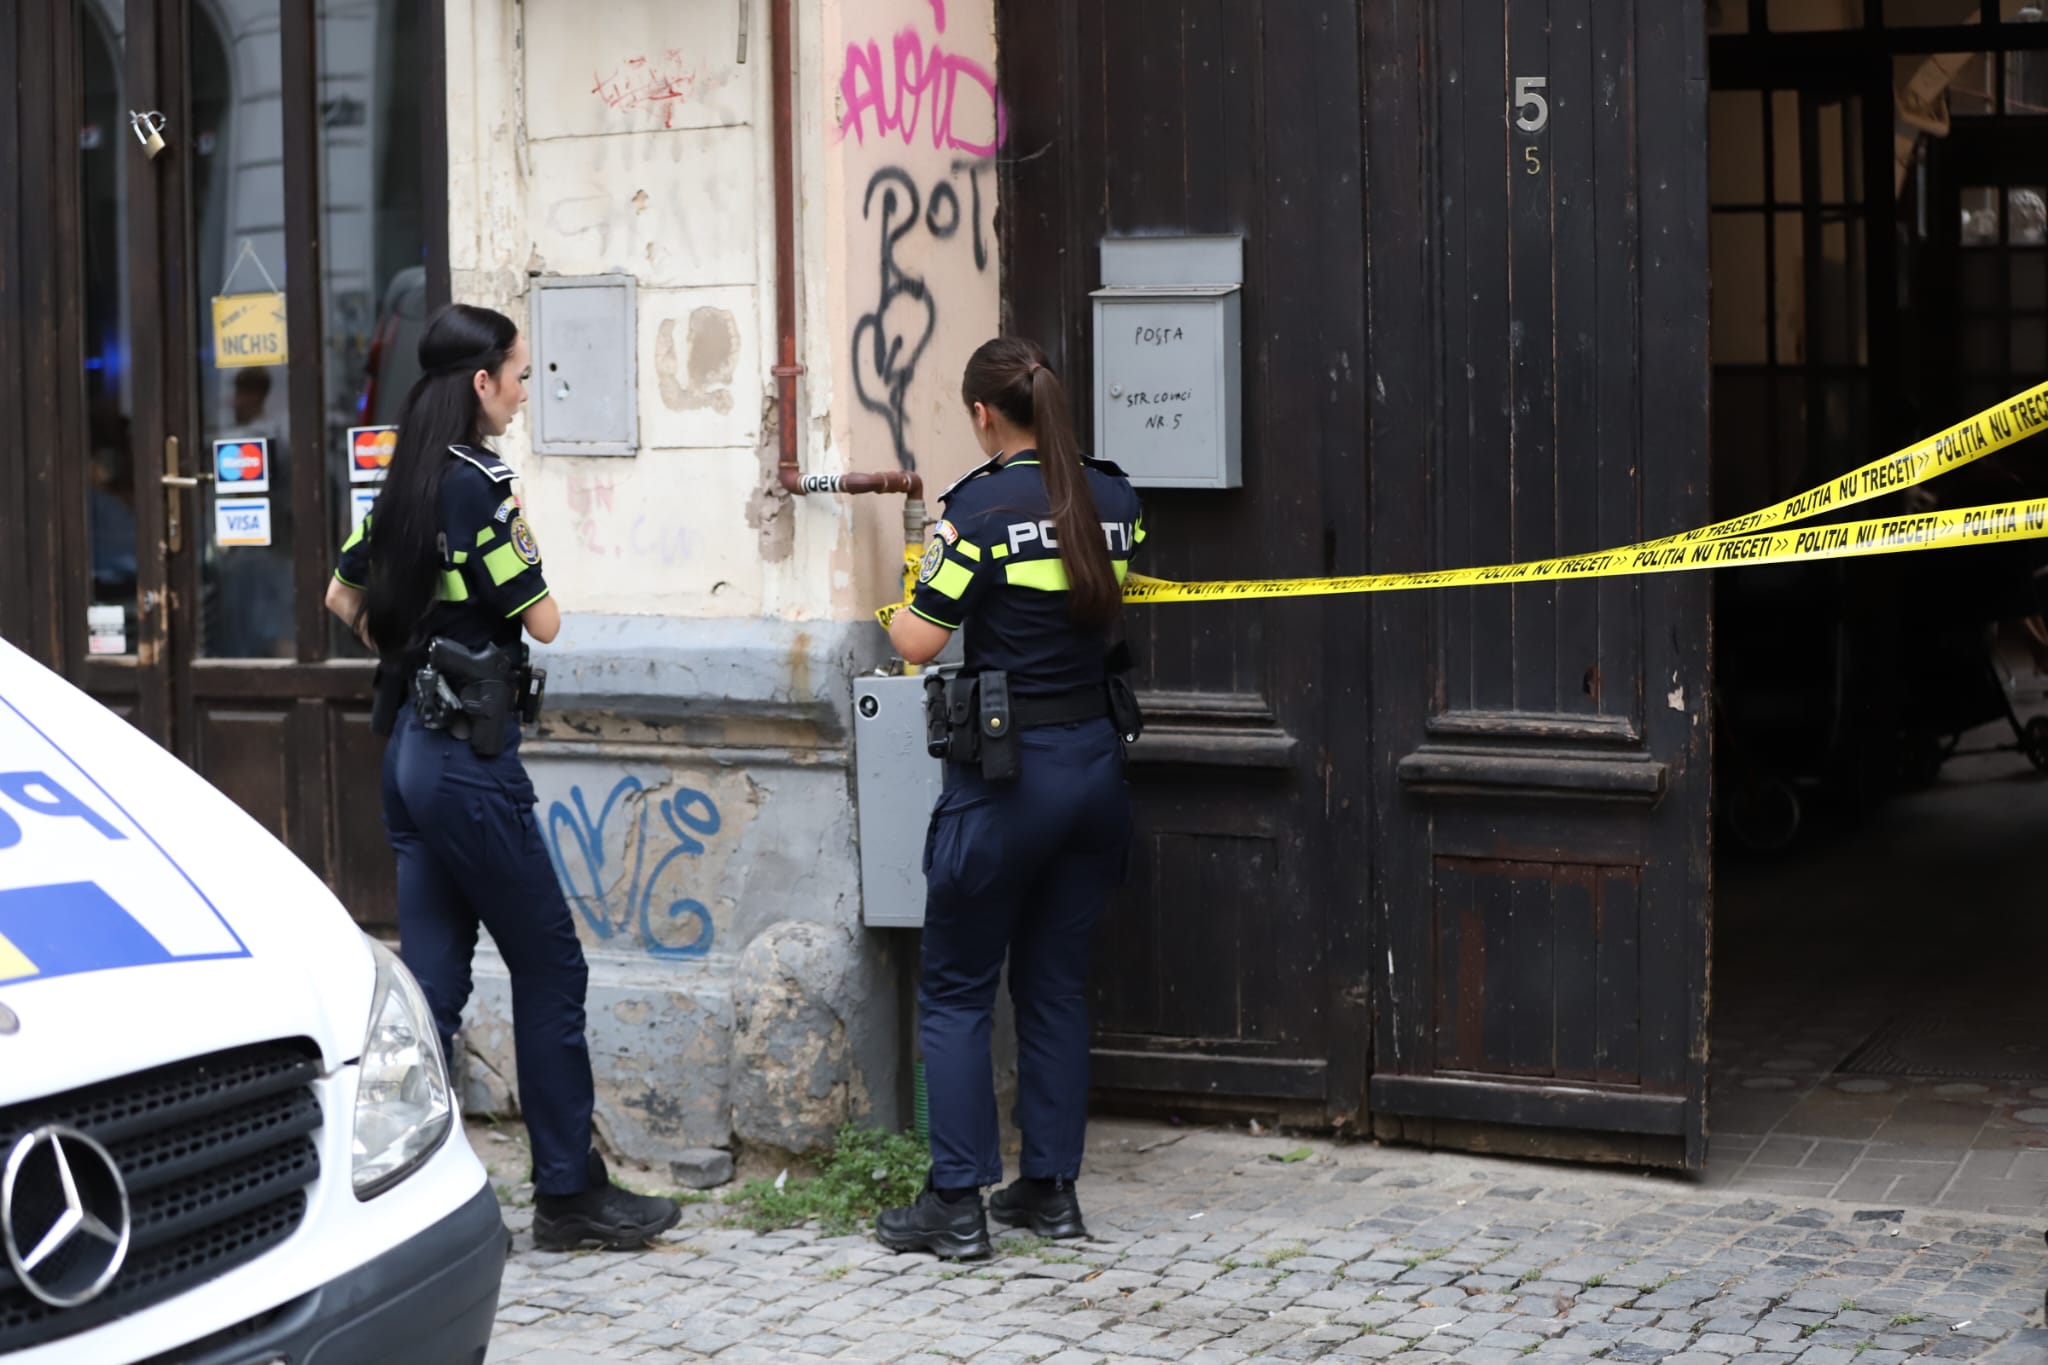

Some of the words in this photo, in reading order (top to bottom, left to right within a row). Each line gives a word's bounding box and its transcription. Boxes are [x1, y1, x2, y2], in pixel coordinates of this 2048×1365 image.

[1515, 76, 1549, 132] 5
[1525, 146, 1541, 175] 5
[1172, 413, 1183, 430] 5
[1839, 476, 1858, 500] NU
[1989, 411, 2011, 442] NU
[1532, 562, 1556, 576] NU
[1691, 543, 1715, 563] NU
[1856, 524, 1878, 549] NU
[2025, 503, 2047, 531] NU
